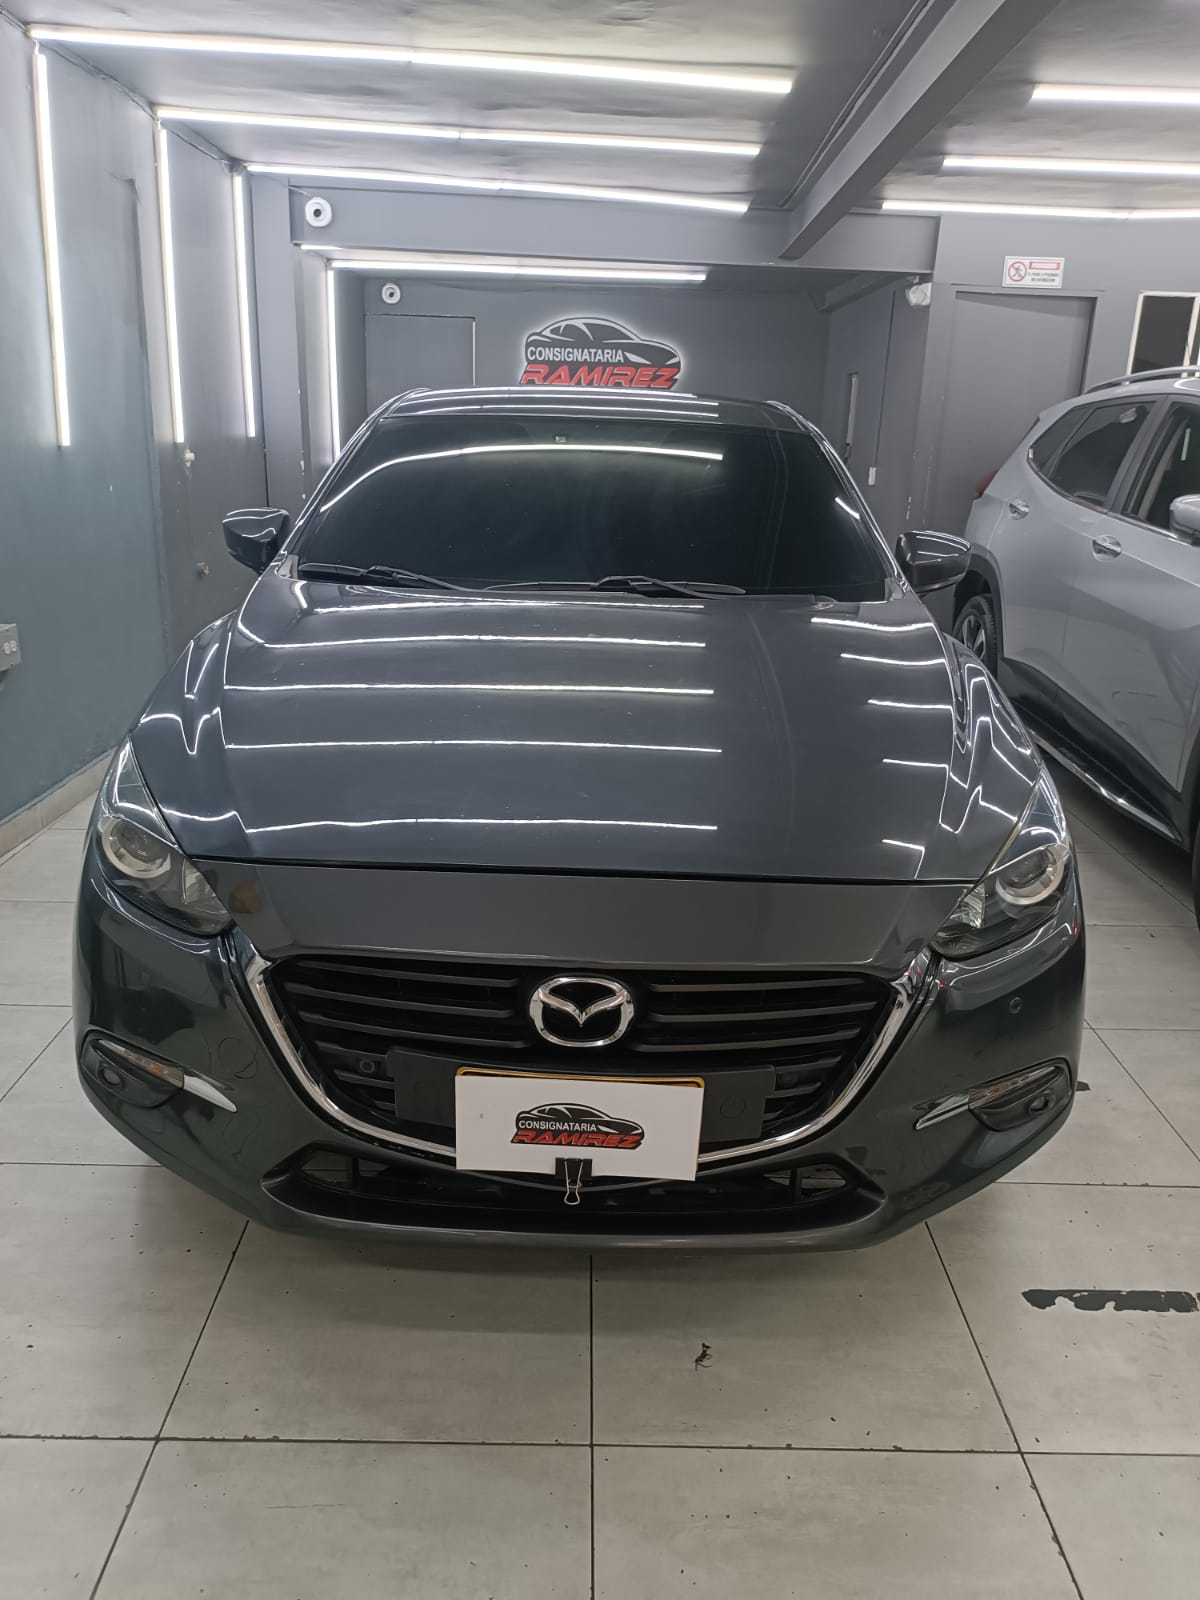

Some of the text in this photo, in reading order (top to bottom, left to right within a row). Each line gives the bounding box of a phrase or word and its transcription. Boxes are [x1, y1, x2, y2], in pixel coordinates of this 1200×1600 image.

[527, 347, 624, 363] CONSIGNATARIA
[520, 363, 680, 388] RAMIREZ
[518, 1120, 597, 1131] CONSIGNATARIA
[514, 1130, 642, 1148] RAMIREZ
